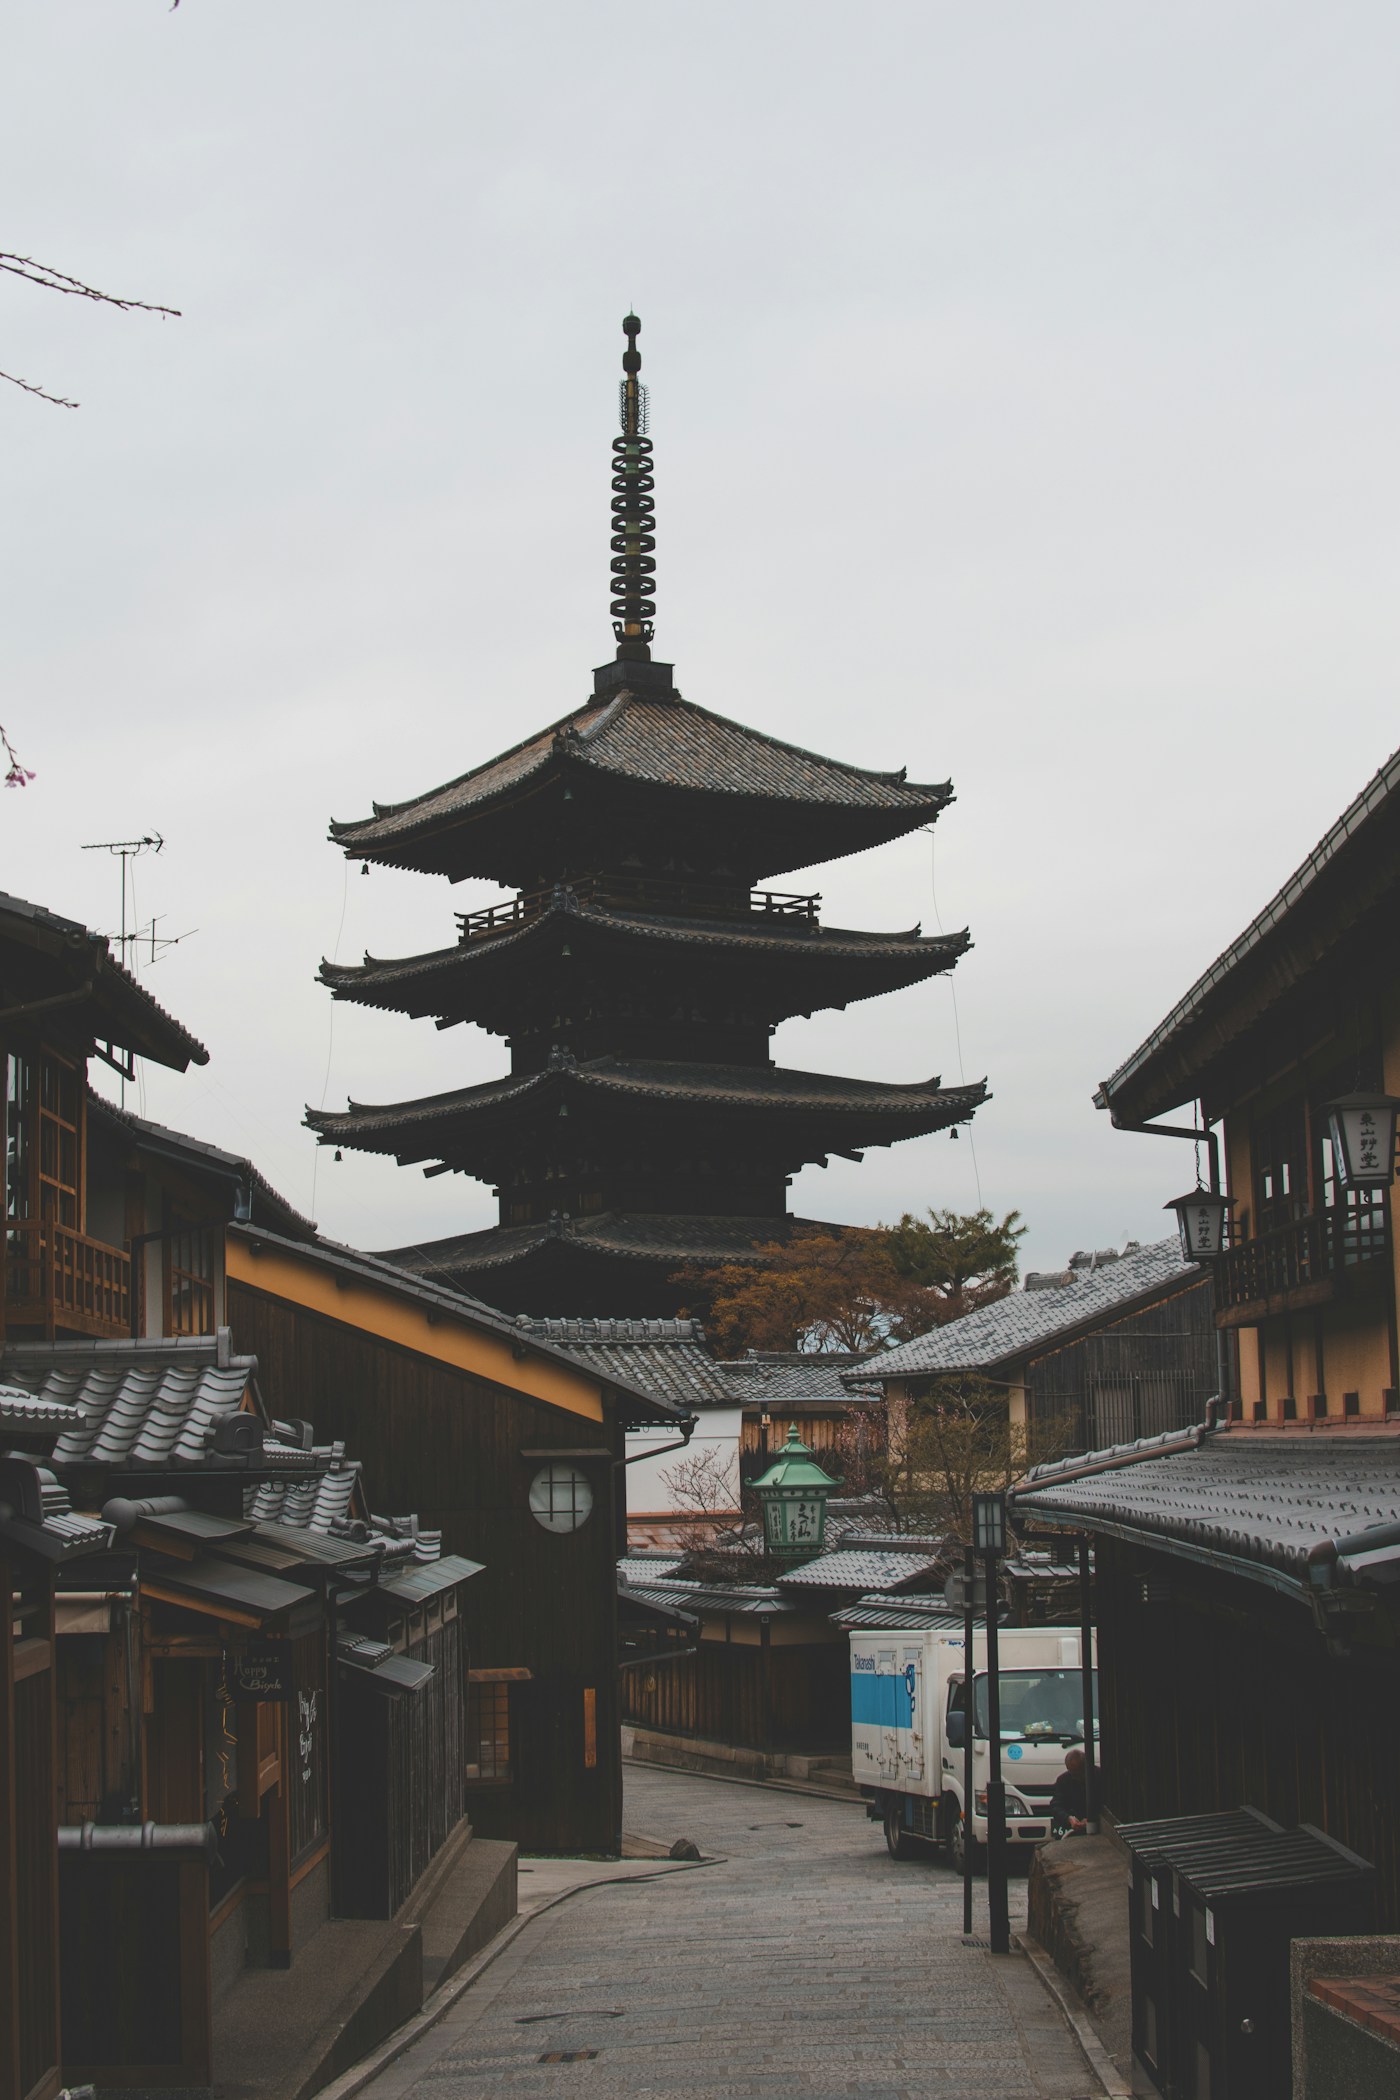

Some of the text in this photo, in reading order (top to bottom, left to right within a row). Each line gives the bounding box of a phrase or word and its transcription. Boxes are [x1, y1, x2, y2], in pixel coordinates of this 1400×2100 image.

[233, 1656, 267, 1679] Happy
[854, 1654, 875, 1670] Takanashi
[241, 1678, 282, 1693] Bicycle
